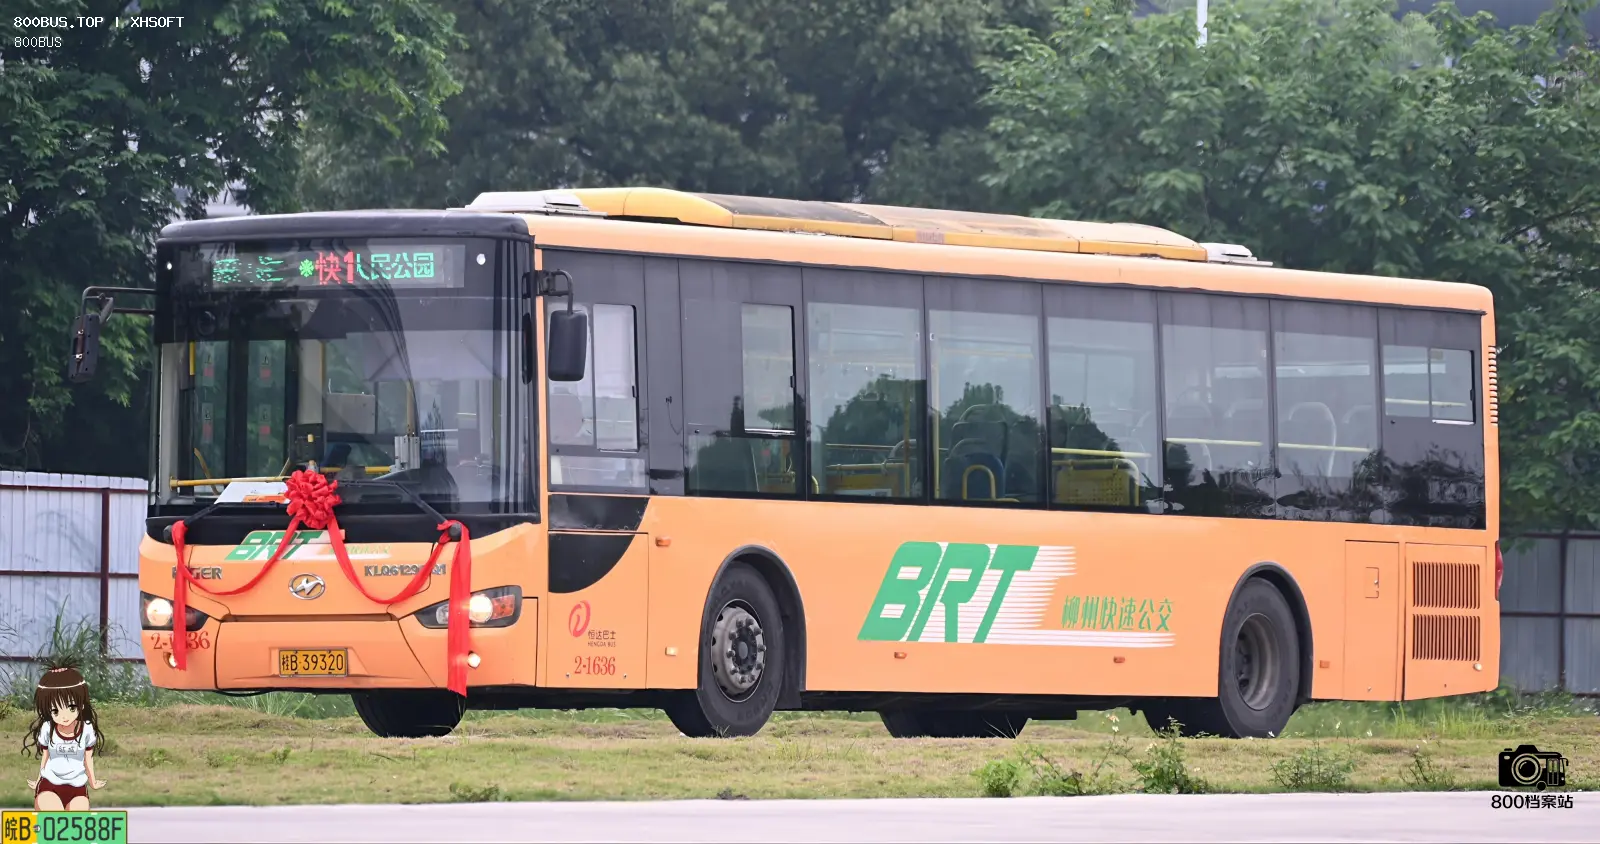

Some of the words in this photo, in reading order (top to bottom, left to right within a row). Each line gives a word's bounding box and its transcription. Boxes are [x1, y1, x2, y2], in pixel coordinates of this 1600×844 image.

[857, 541, 1040, 644] BRT
[1061, 595, 1176, 632] 柳州快速公交
[150, 631, 211, 650] 2-136
[587, 629, 616, 640] 恒达巴士
